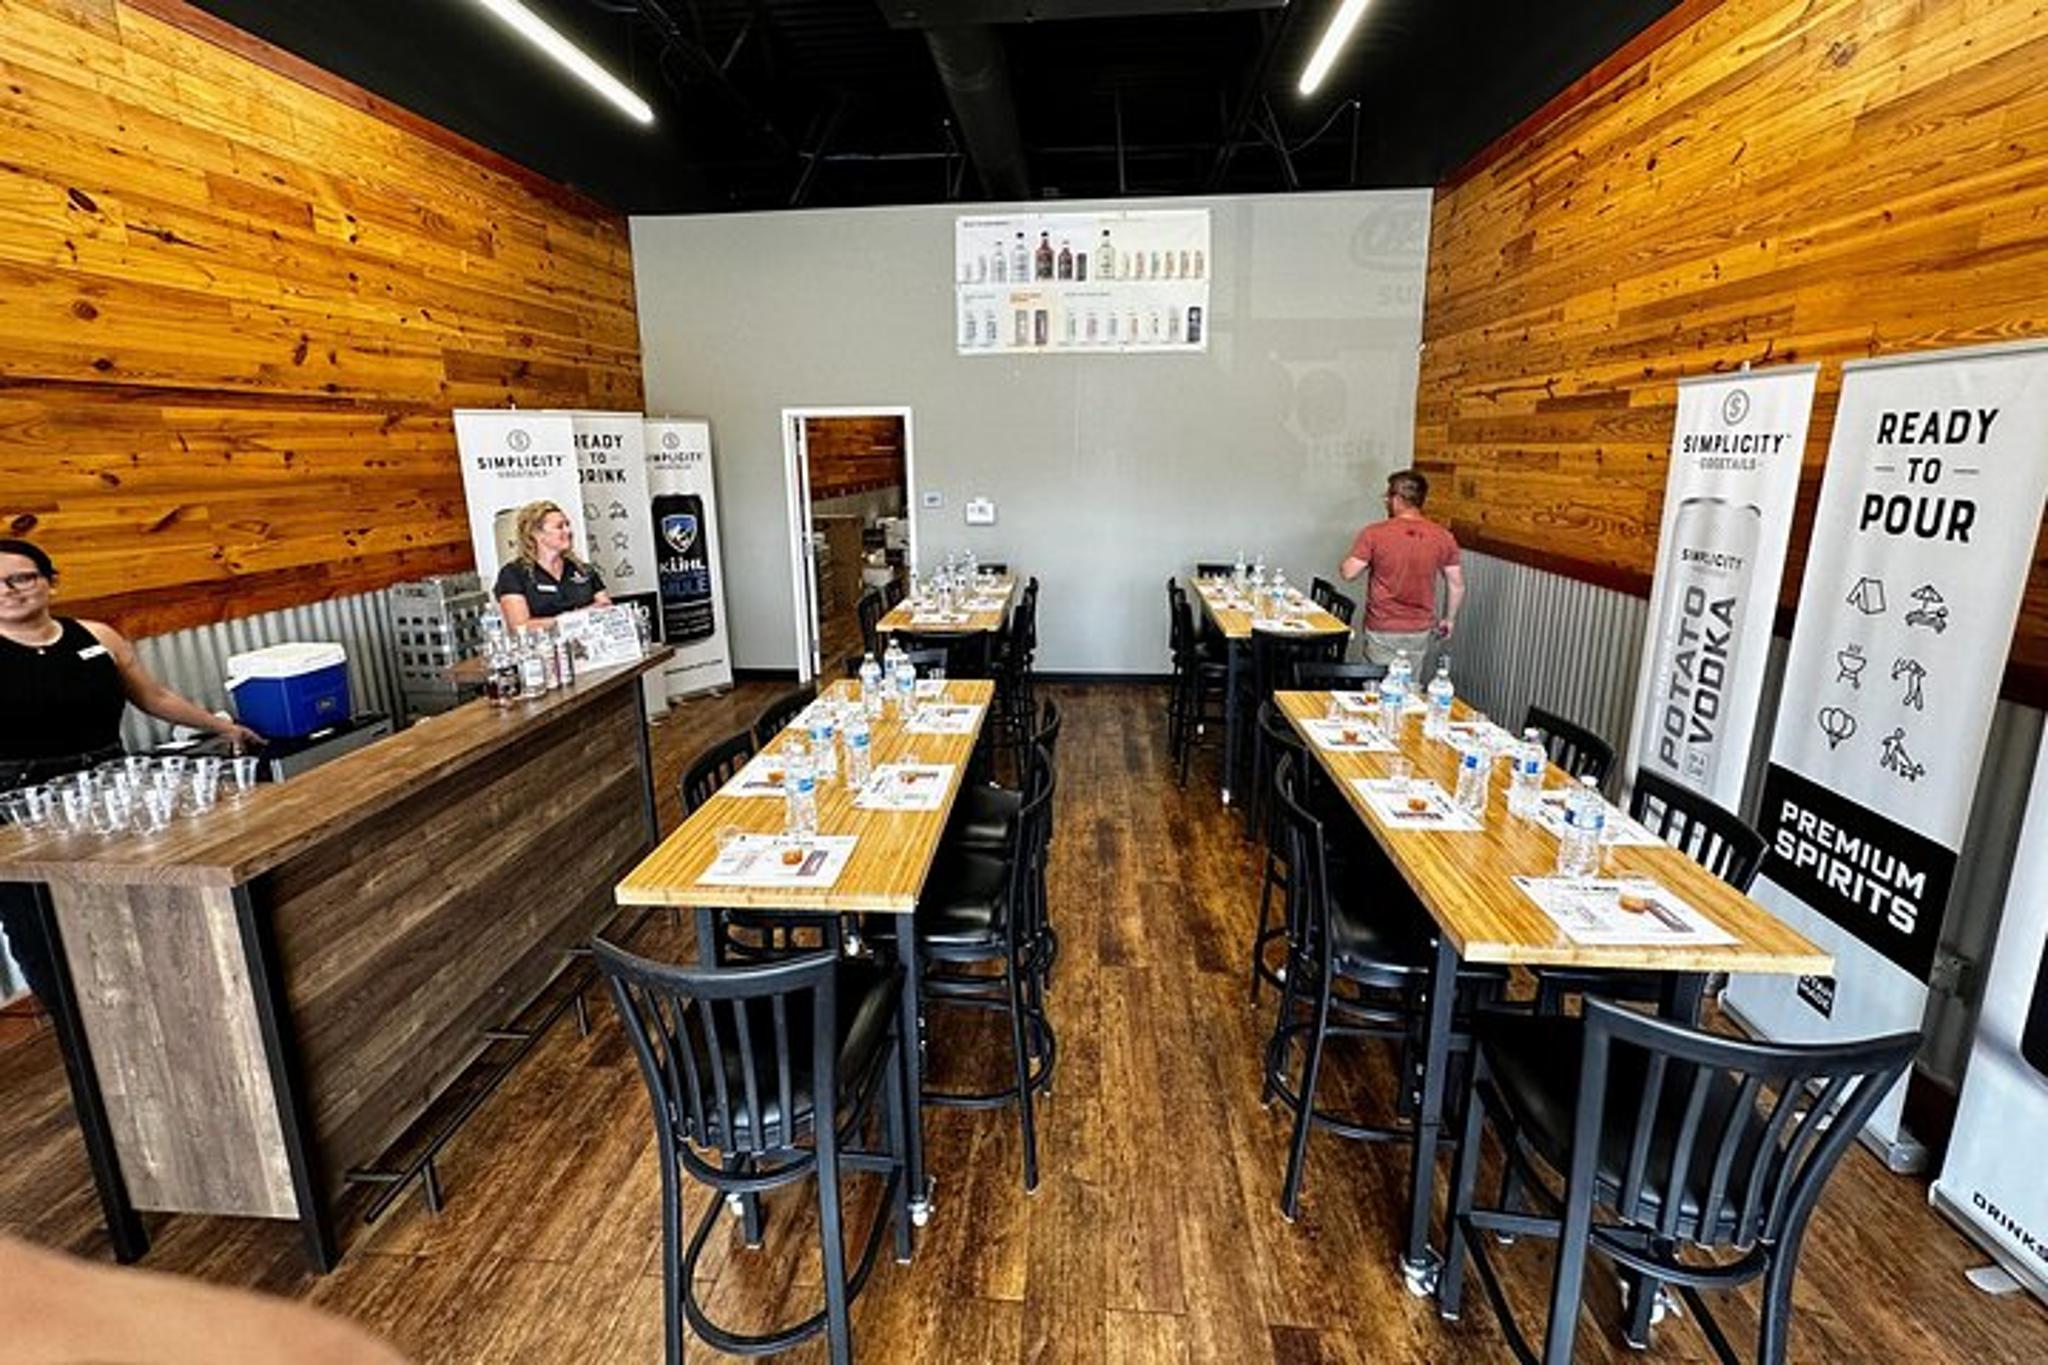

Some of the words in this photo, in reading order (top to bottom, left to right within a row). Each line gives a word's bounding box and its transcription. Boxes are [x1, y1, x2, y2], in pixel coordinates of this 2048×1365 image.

[1877, 408, 1999, 444] READY
[590, 452, 607, 464] TO
[645, 452, 702, 462] IMPLICITY
[1683, 434, 1784, 453] SIMPLICITY
[477, 454, 564, 469] SIMPLICITY
[1908, 457, 1942, 484] TO
[1860, 494, 1976, 543] POUR
[1683, 549, 1743, 570] SIMPLICITY
[1660, 586, 1706, 770] POTATO
[1688, 598, 1736, 743] VODKA
[1780, 800, 1926, 900] PREMIUM
[1774, 828, 1918, 934] SPIRITS
